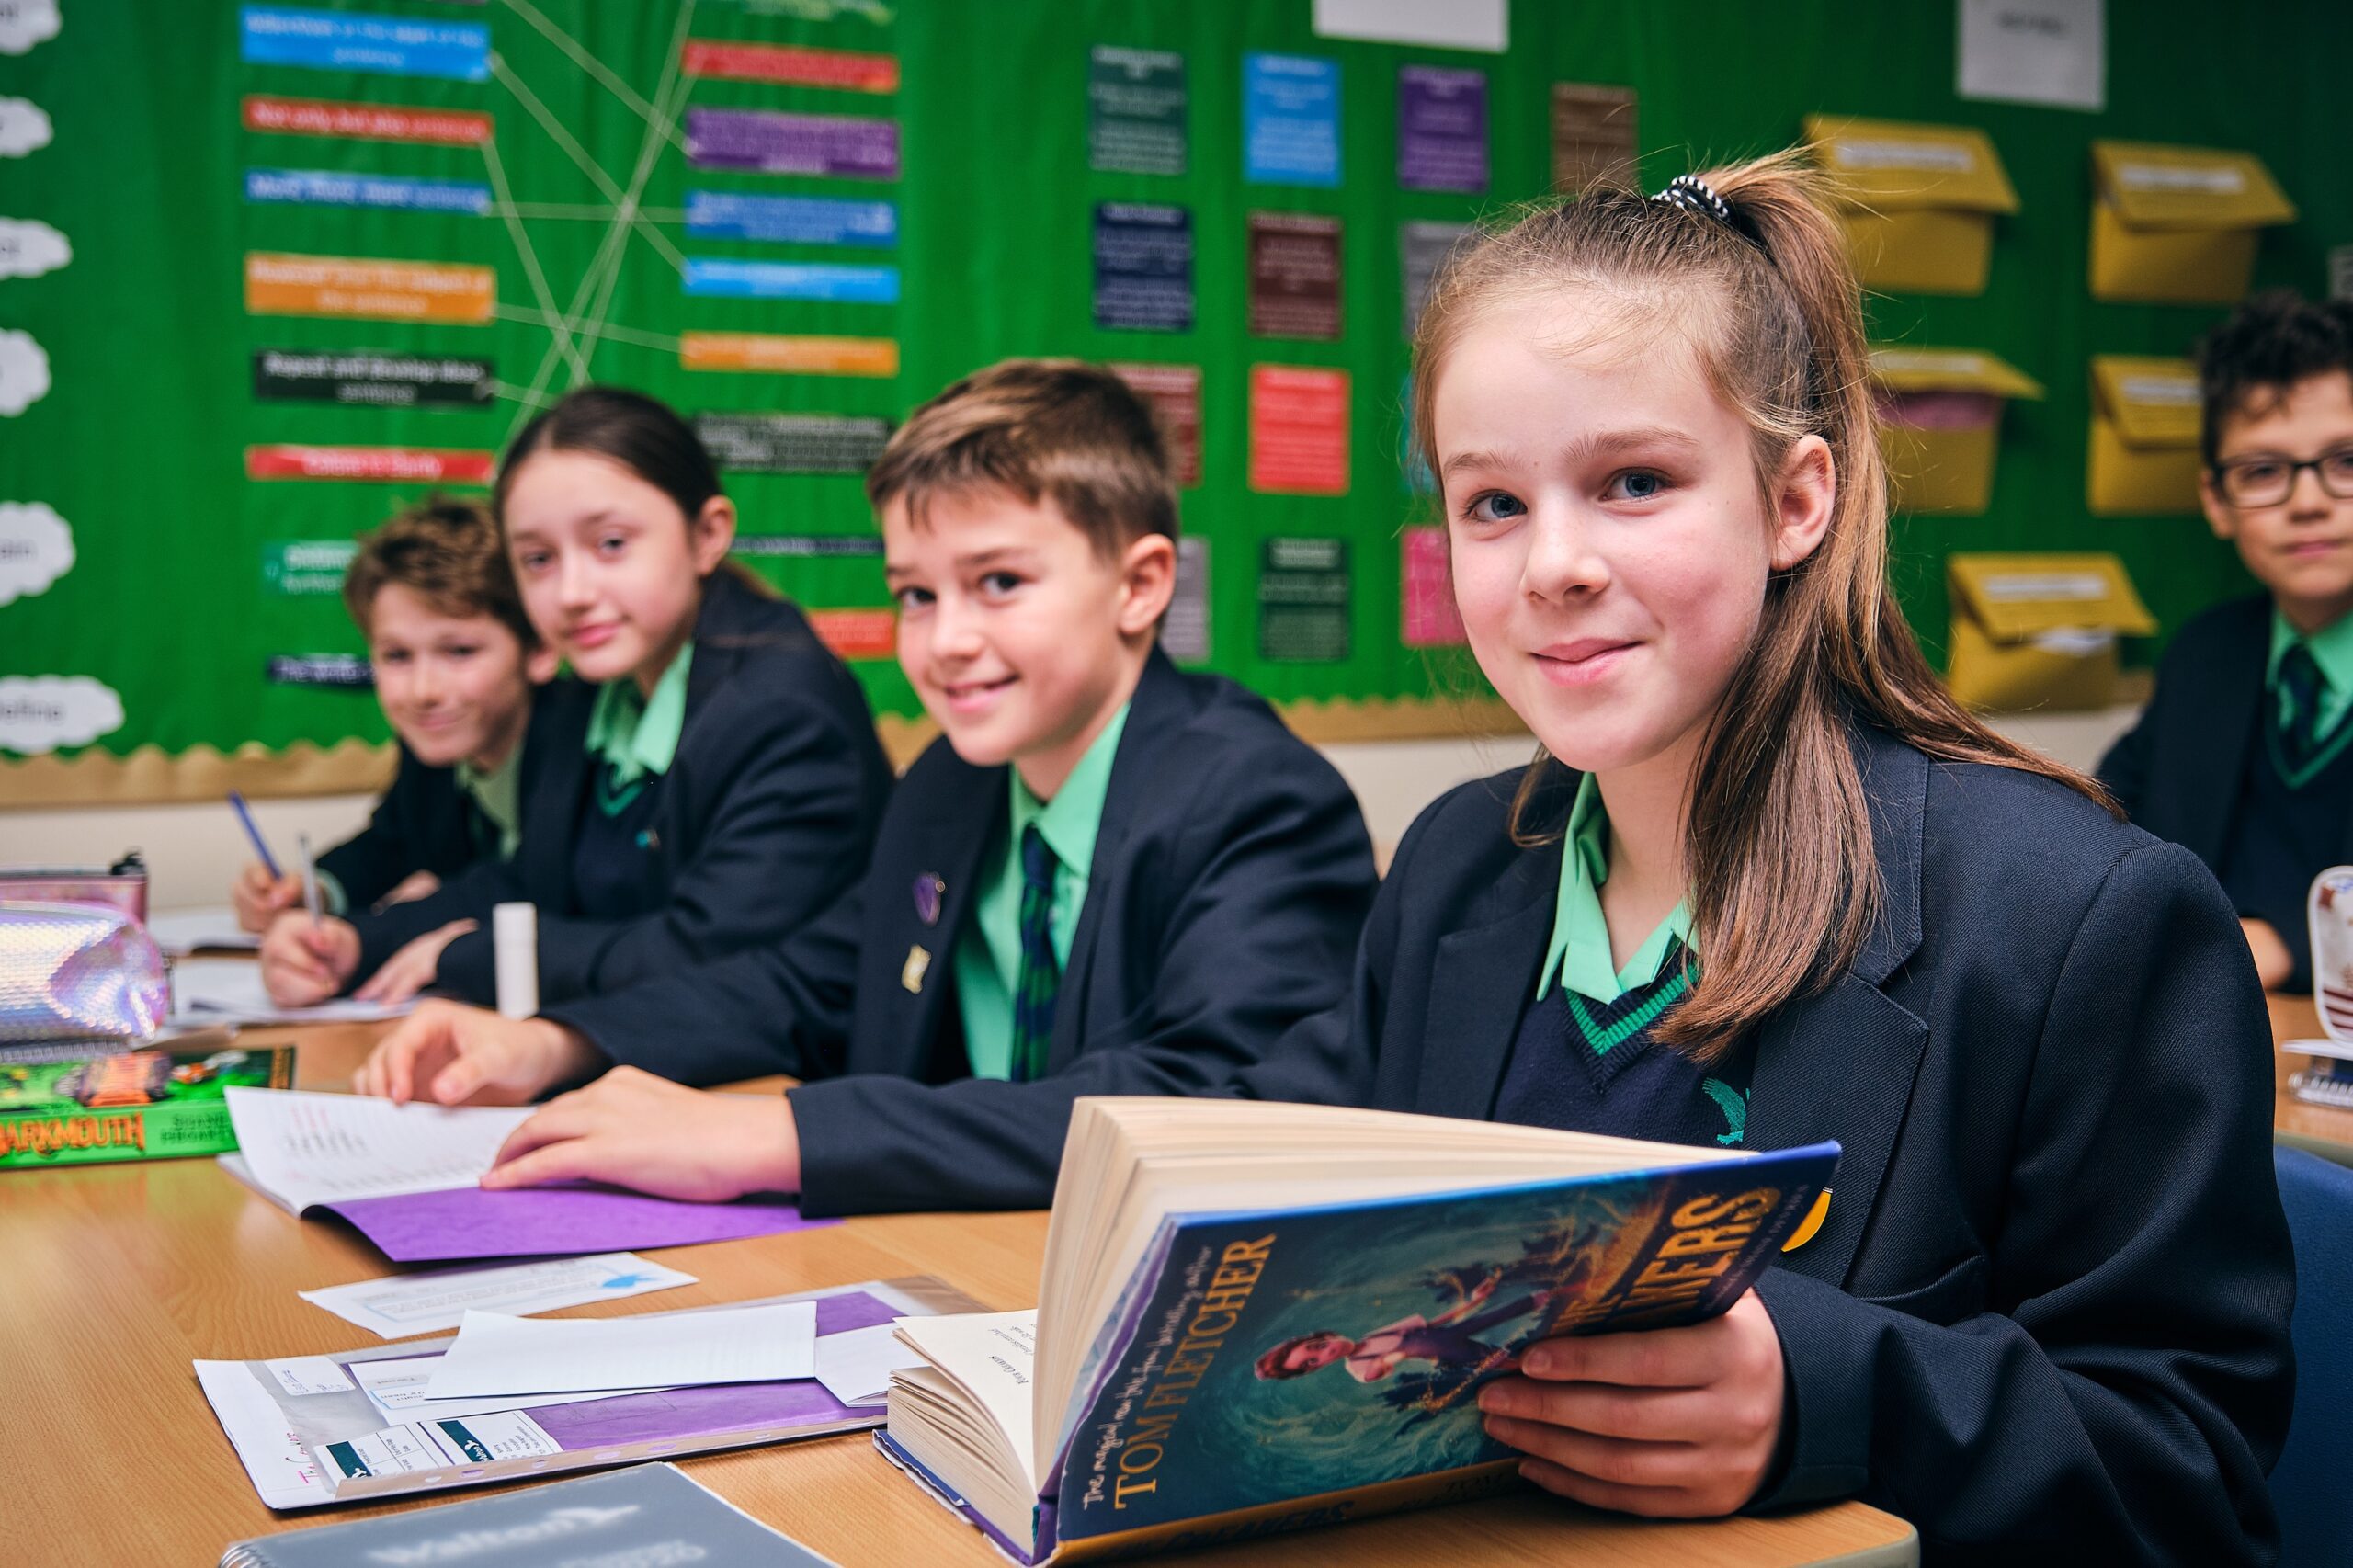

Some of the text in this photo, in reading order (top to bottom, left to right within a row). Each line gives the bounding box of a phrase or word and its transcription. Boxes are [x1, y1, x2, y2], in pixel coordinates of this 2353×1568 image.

[1113, 1232, 1278, 1510] TOM FLETCHER
[1082, 1472, 1106, 1511] The
